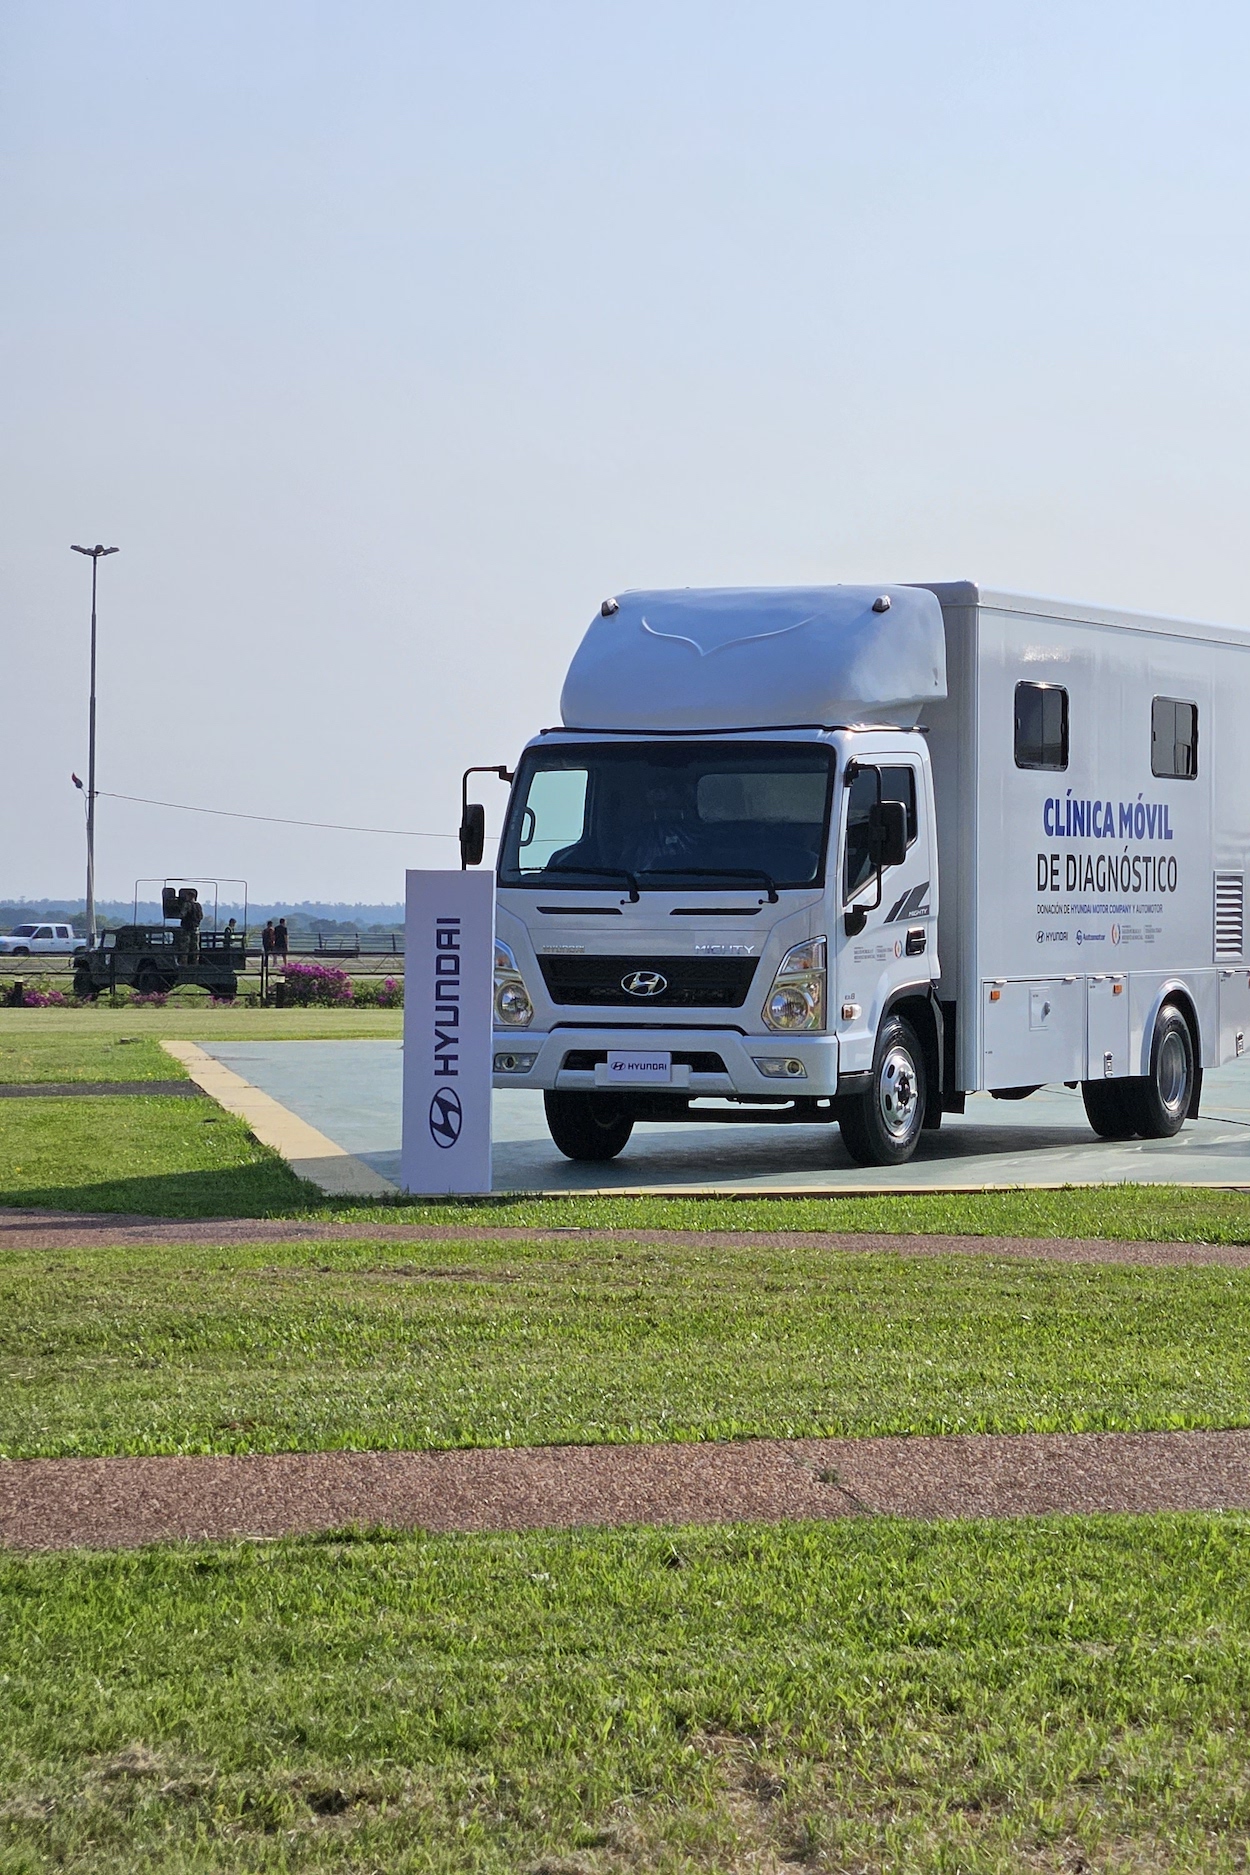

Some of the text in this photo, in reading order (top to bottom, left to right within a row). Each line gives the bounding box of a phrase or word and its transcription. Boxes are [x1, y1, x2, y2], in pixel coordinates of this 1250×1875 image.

[1043, 789, 1173, 840] CLÍNICA MÓVIL
[1037, 845, 1177, 893] DE DIAGNÓSTICO
[908, 908, 928, 917] MIGHTY
[1036, 901, 1063, 914] DONACIÓN
[1064, 904, 1070, 914] DE
[1070, 904, 1091, 914] HYUNDAI
[1092, 904, 1108, 914] MOTOR
[1109, 904, 1131, 914] COMPANY
[1136, 904, 1163, 914] AUTOMOTOR
[1046, 932, 1068, 941] HYUNDAI
[434, 918, 461, 1076] HYUNDAI
[627, 1062, 667, 1071] HYUNDAI
